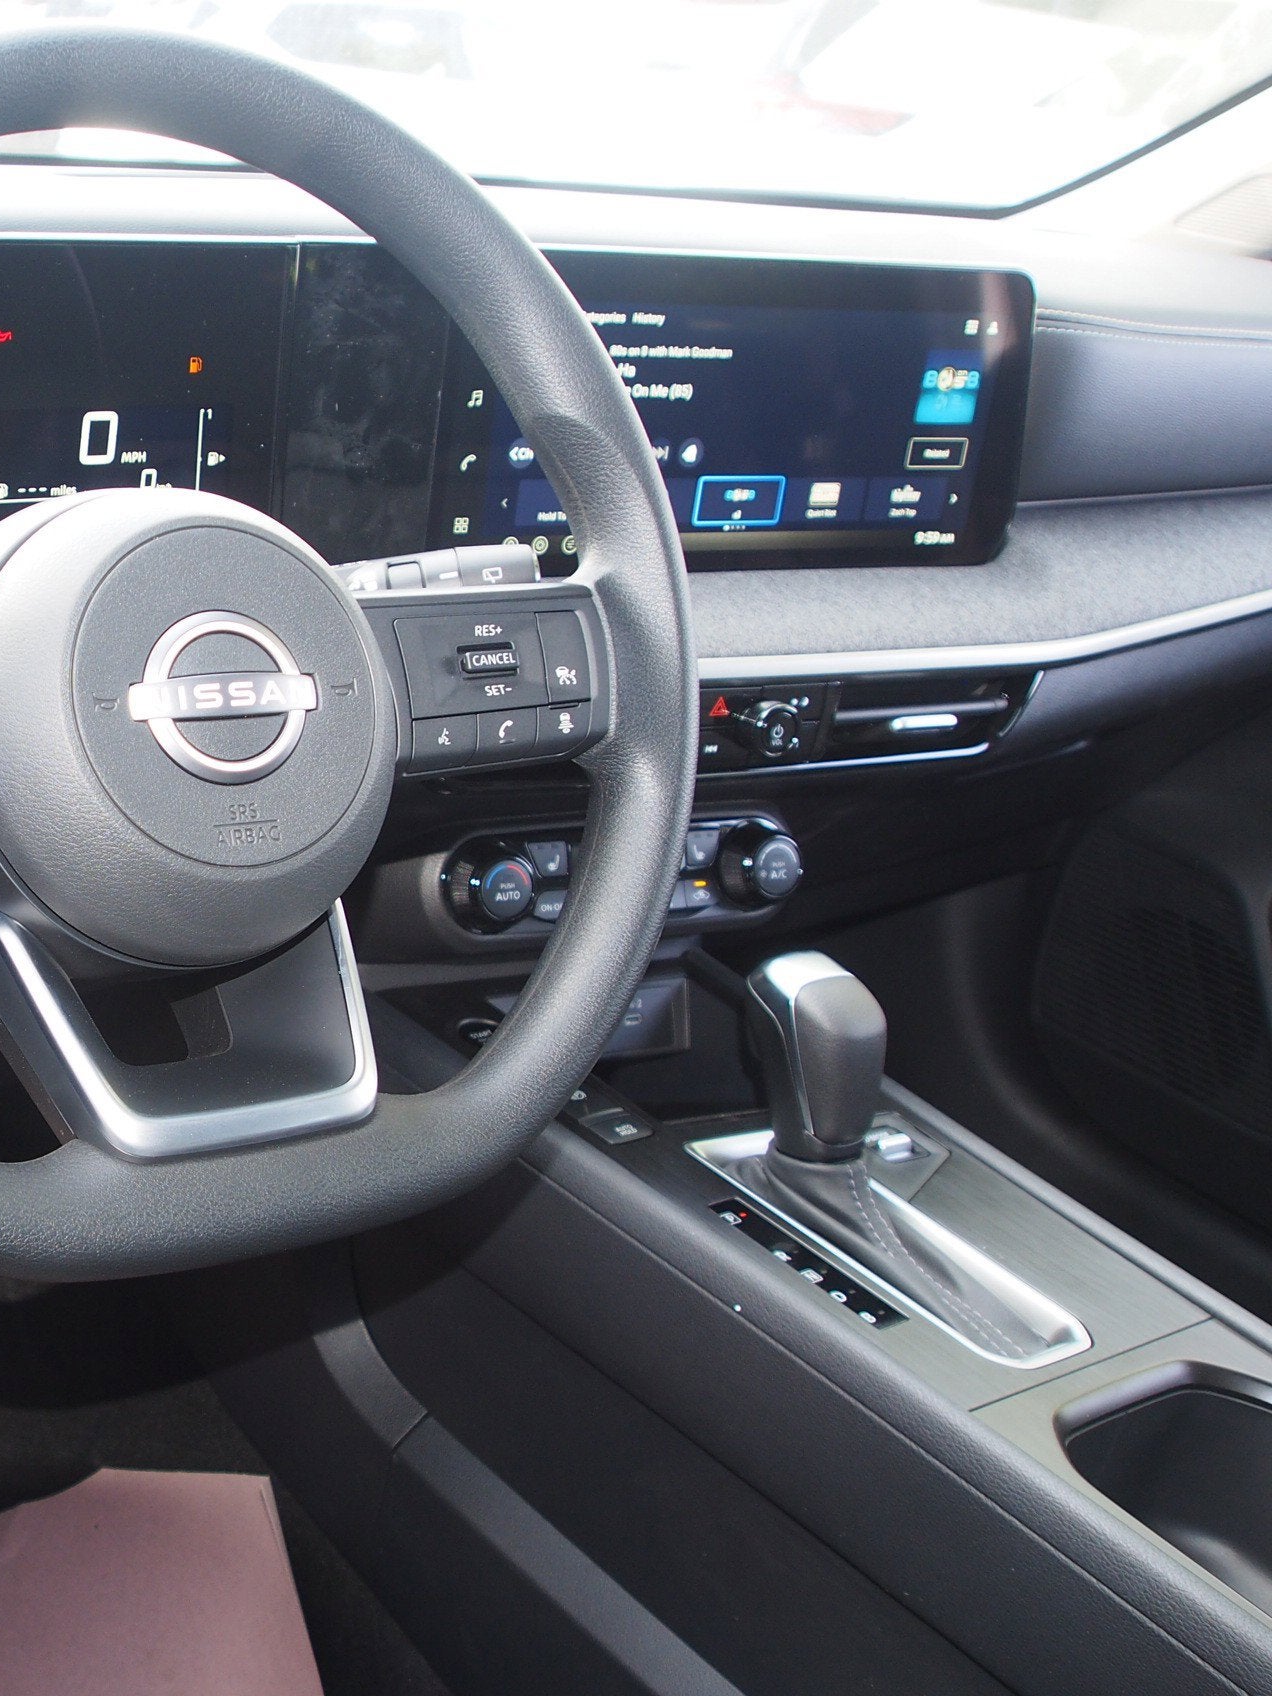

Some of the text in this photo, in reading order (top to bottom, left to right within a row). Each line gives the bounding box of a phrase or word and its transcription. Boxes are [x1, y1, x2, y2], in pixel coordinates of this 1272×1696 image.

[585, 311, 626, 326] ategories
[632, 312, 665, 327] History
[628, 347, 640, 358] on
[648, 345, 667, 358] with
[667, 346, 690, 359] Mark
[691, 346, 733, 360] Goodman
[632, 383, 649, 399] On
[649, 384, 668, 399] Me
[79, 410, 147, 465] 0 MPH
[50, 484, 77, 497] miles
[474, 625, 503, 637] RES+
[472, 652, 516, 667] CANCEL
[484, 685, 513, 697] SET-
[228, 803, 259, 821] SRS
[216, 825, 283, 847] AIRBAG
[771, 869, 788, 879] A/C
[496, 890, 521, 901] AUTO
